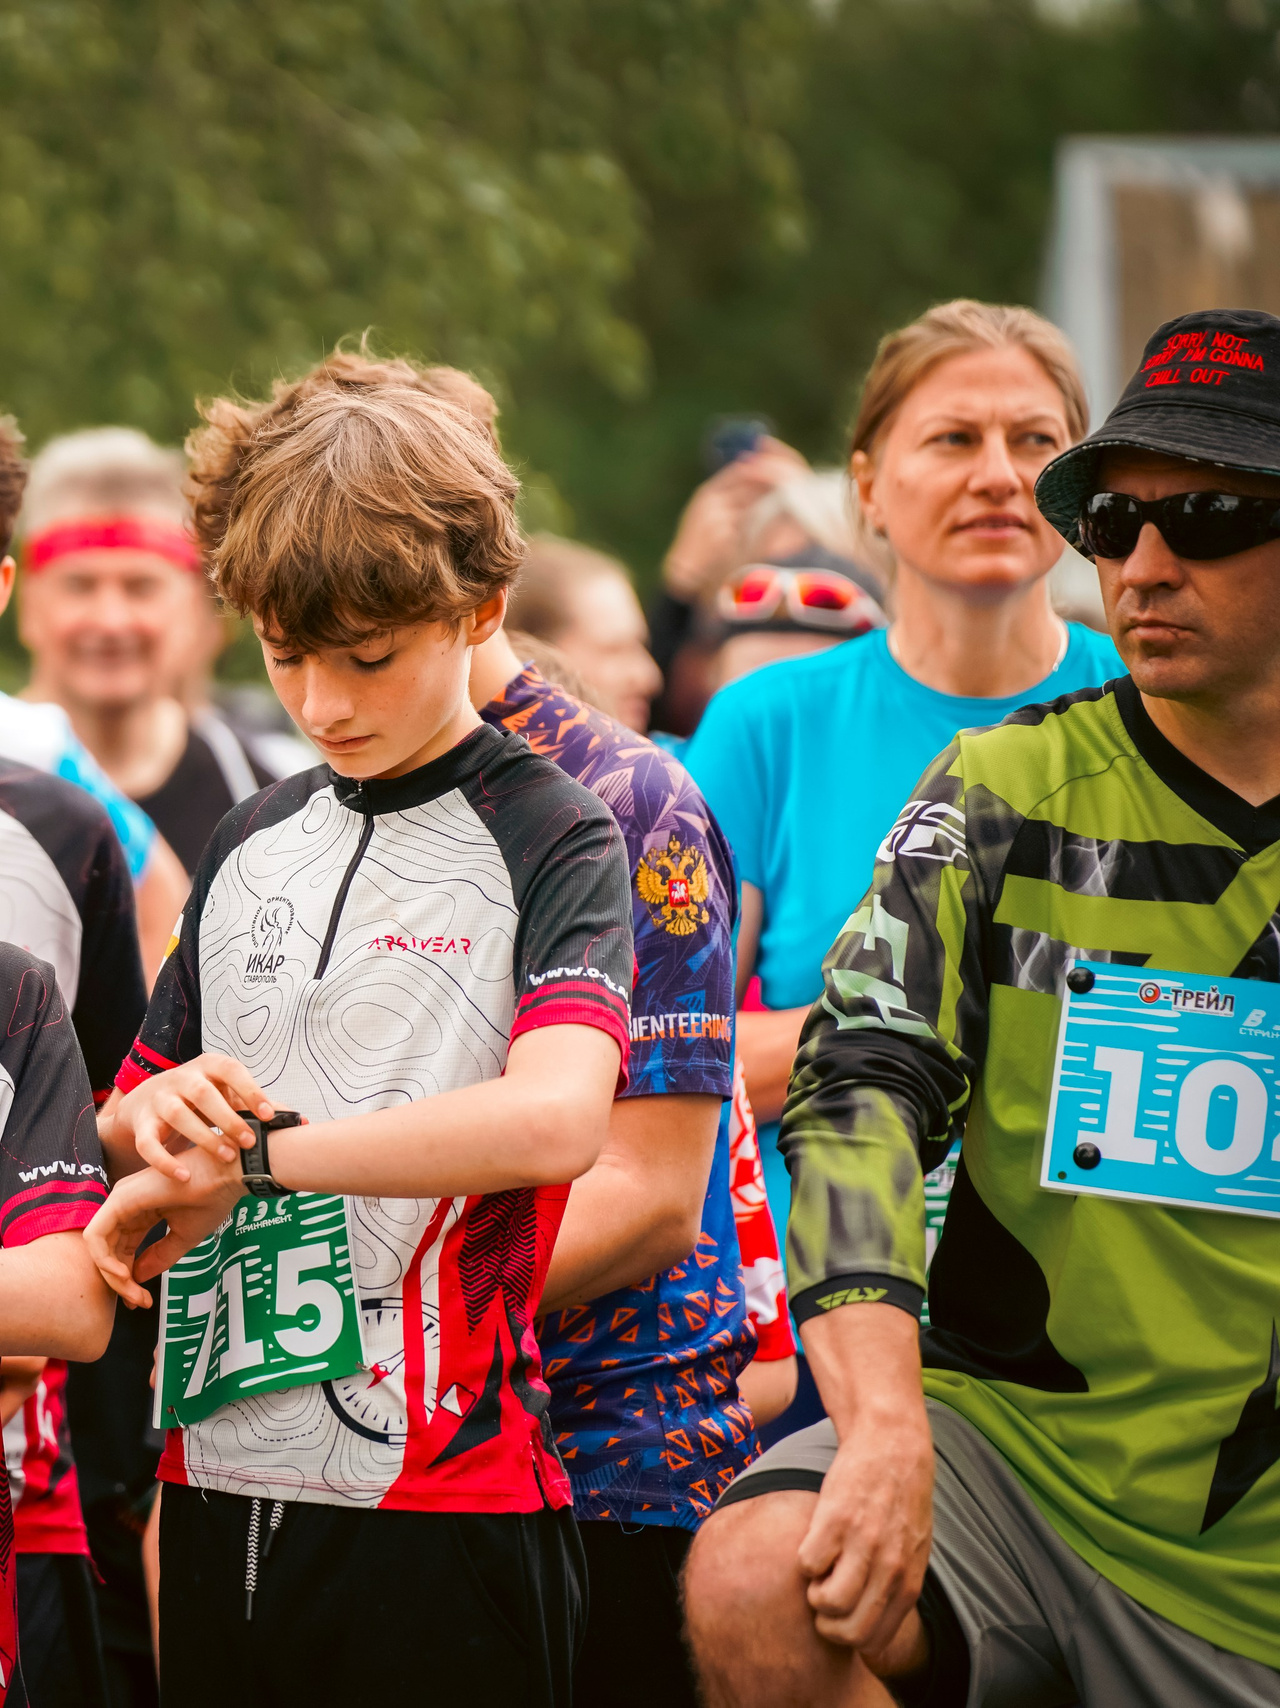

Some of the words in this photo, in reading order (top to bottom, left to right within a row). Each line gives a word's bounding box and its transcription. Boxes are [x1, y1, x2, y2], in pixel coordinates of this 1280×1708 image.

[1163, 331, 1208, 351] SORRY
[1211, 331, 1249, 350] NOT
[1180, 346, 1208, 362] I'M
[1209, 348, 1264, 372] GONNA
[1145, 368, 1181, 388] CHILL
[1190, 368, 1230, 385] OUT
[245, 953, 285, 973] ИКАР
[243, 975, 277, 984] СТАВРОПОЛЬ
[1076, 1045, 1280, 1176] 10
[235, 1214, 293, 1236] СТРИЖАМЕНТ
[183, 1241, 344, 1399] 715
